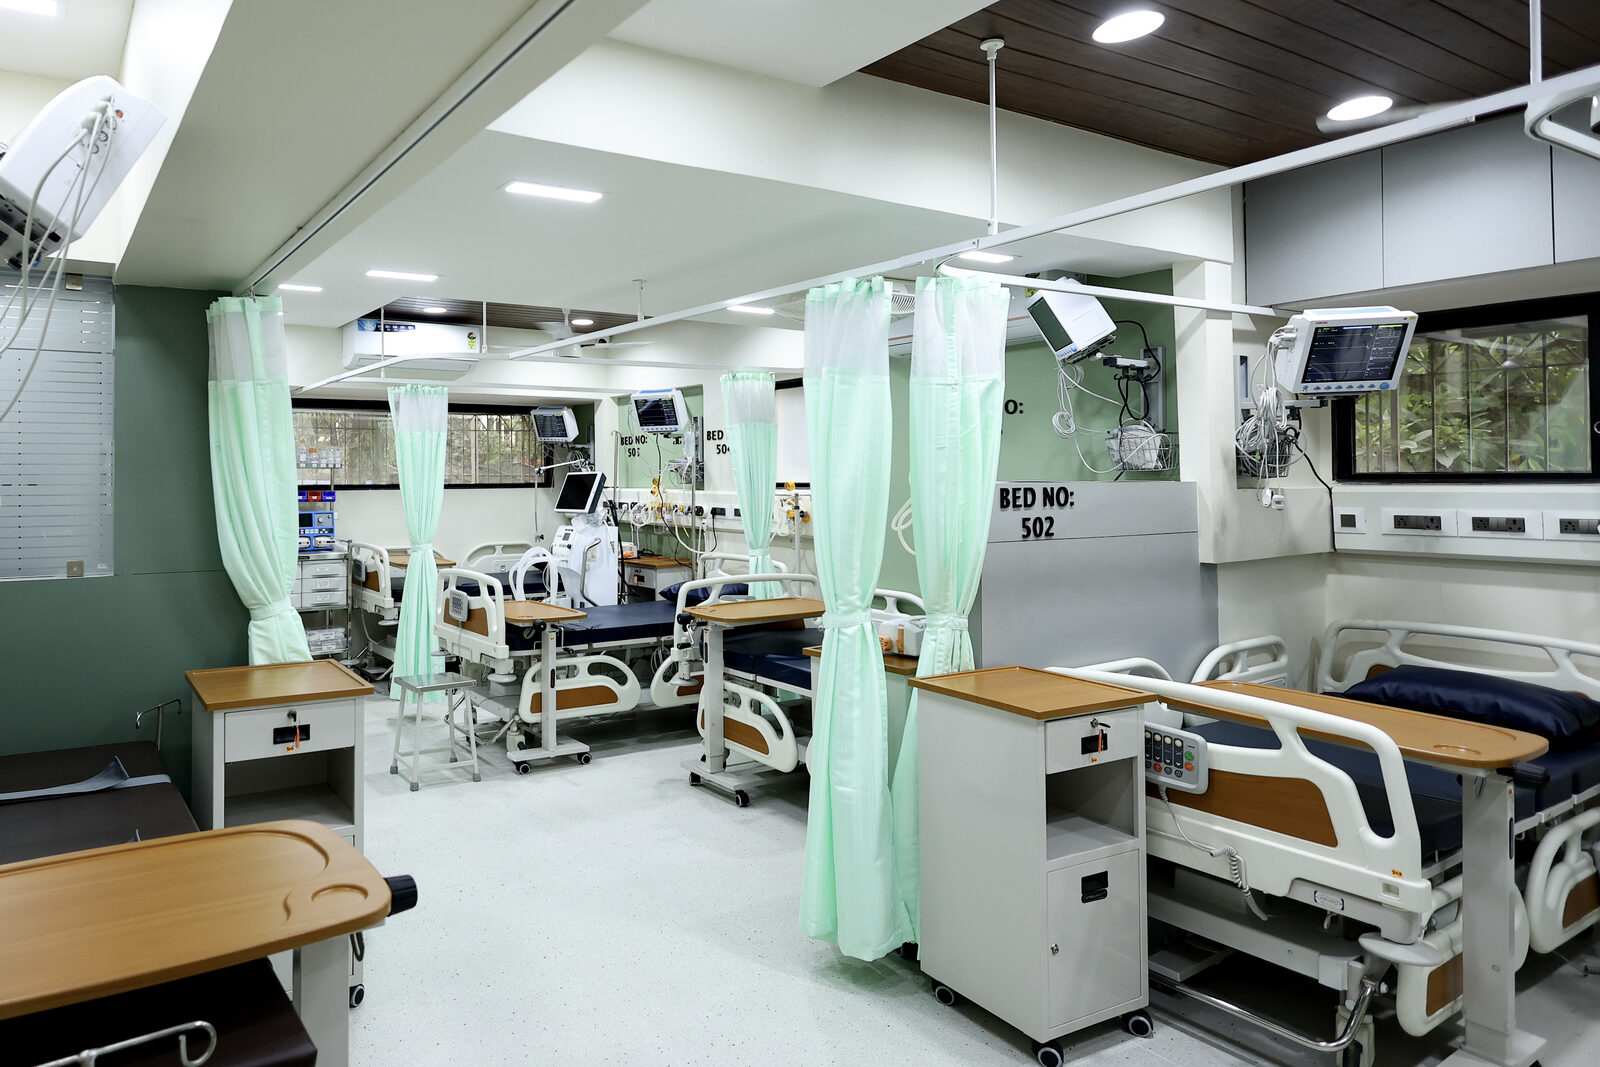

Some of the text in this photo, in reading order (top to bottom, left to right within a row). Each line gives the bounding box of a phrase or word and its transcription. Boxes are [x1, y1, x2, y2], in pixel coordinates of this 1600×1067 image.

[1004, 399, 1024, 415] O:
[620, 435, 648, 446] BED NO:
[706, 430, 724, 441] BED
[716, 444, 730, 454] 50
[1000, 486, 1075, 509] BED NO:
[1021, 516, 1055, 539] 502
